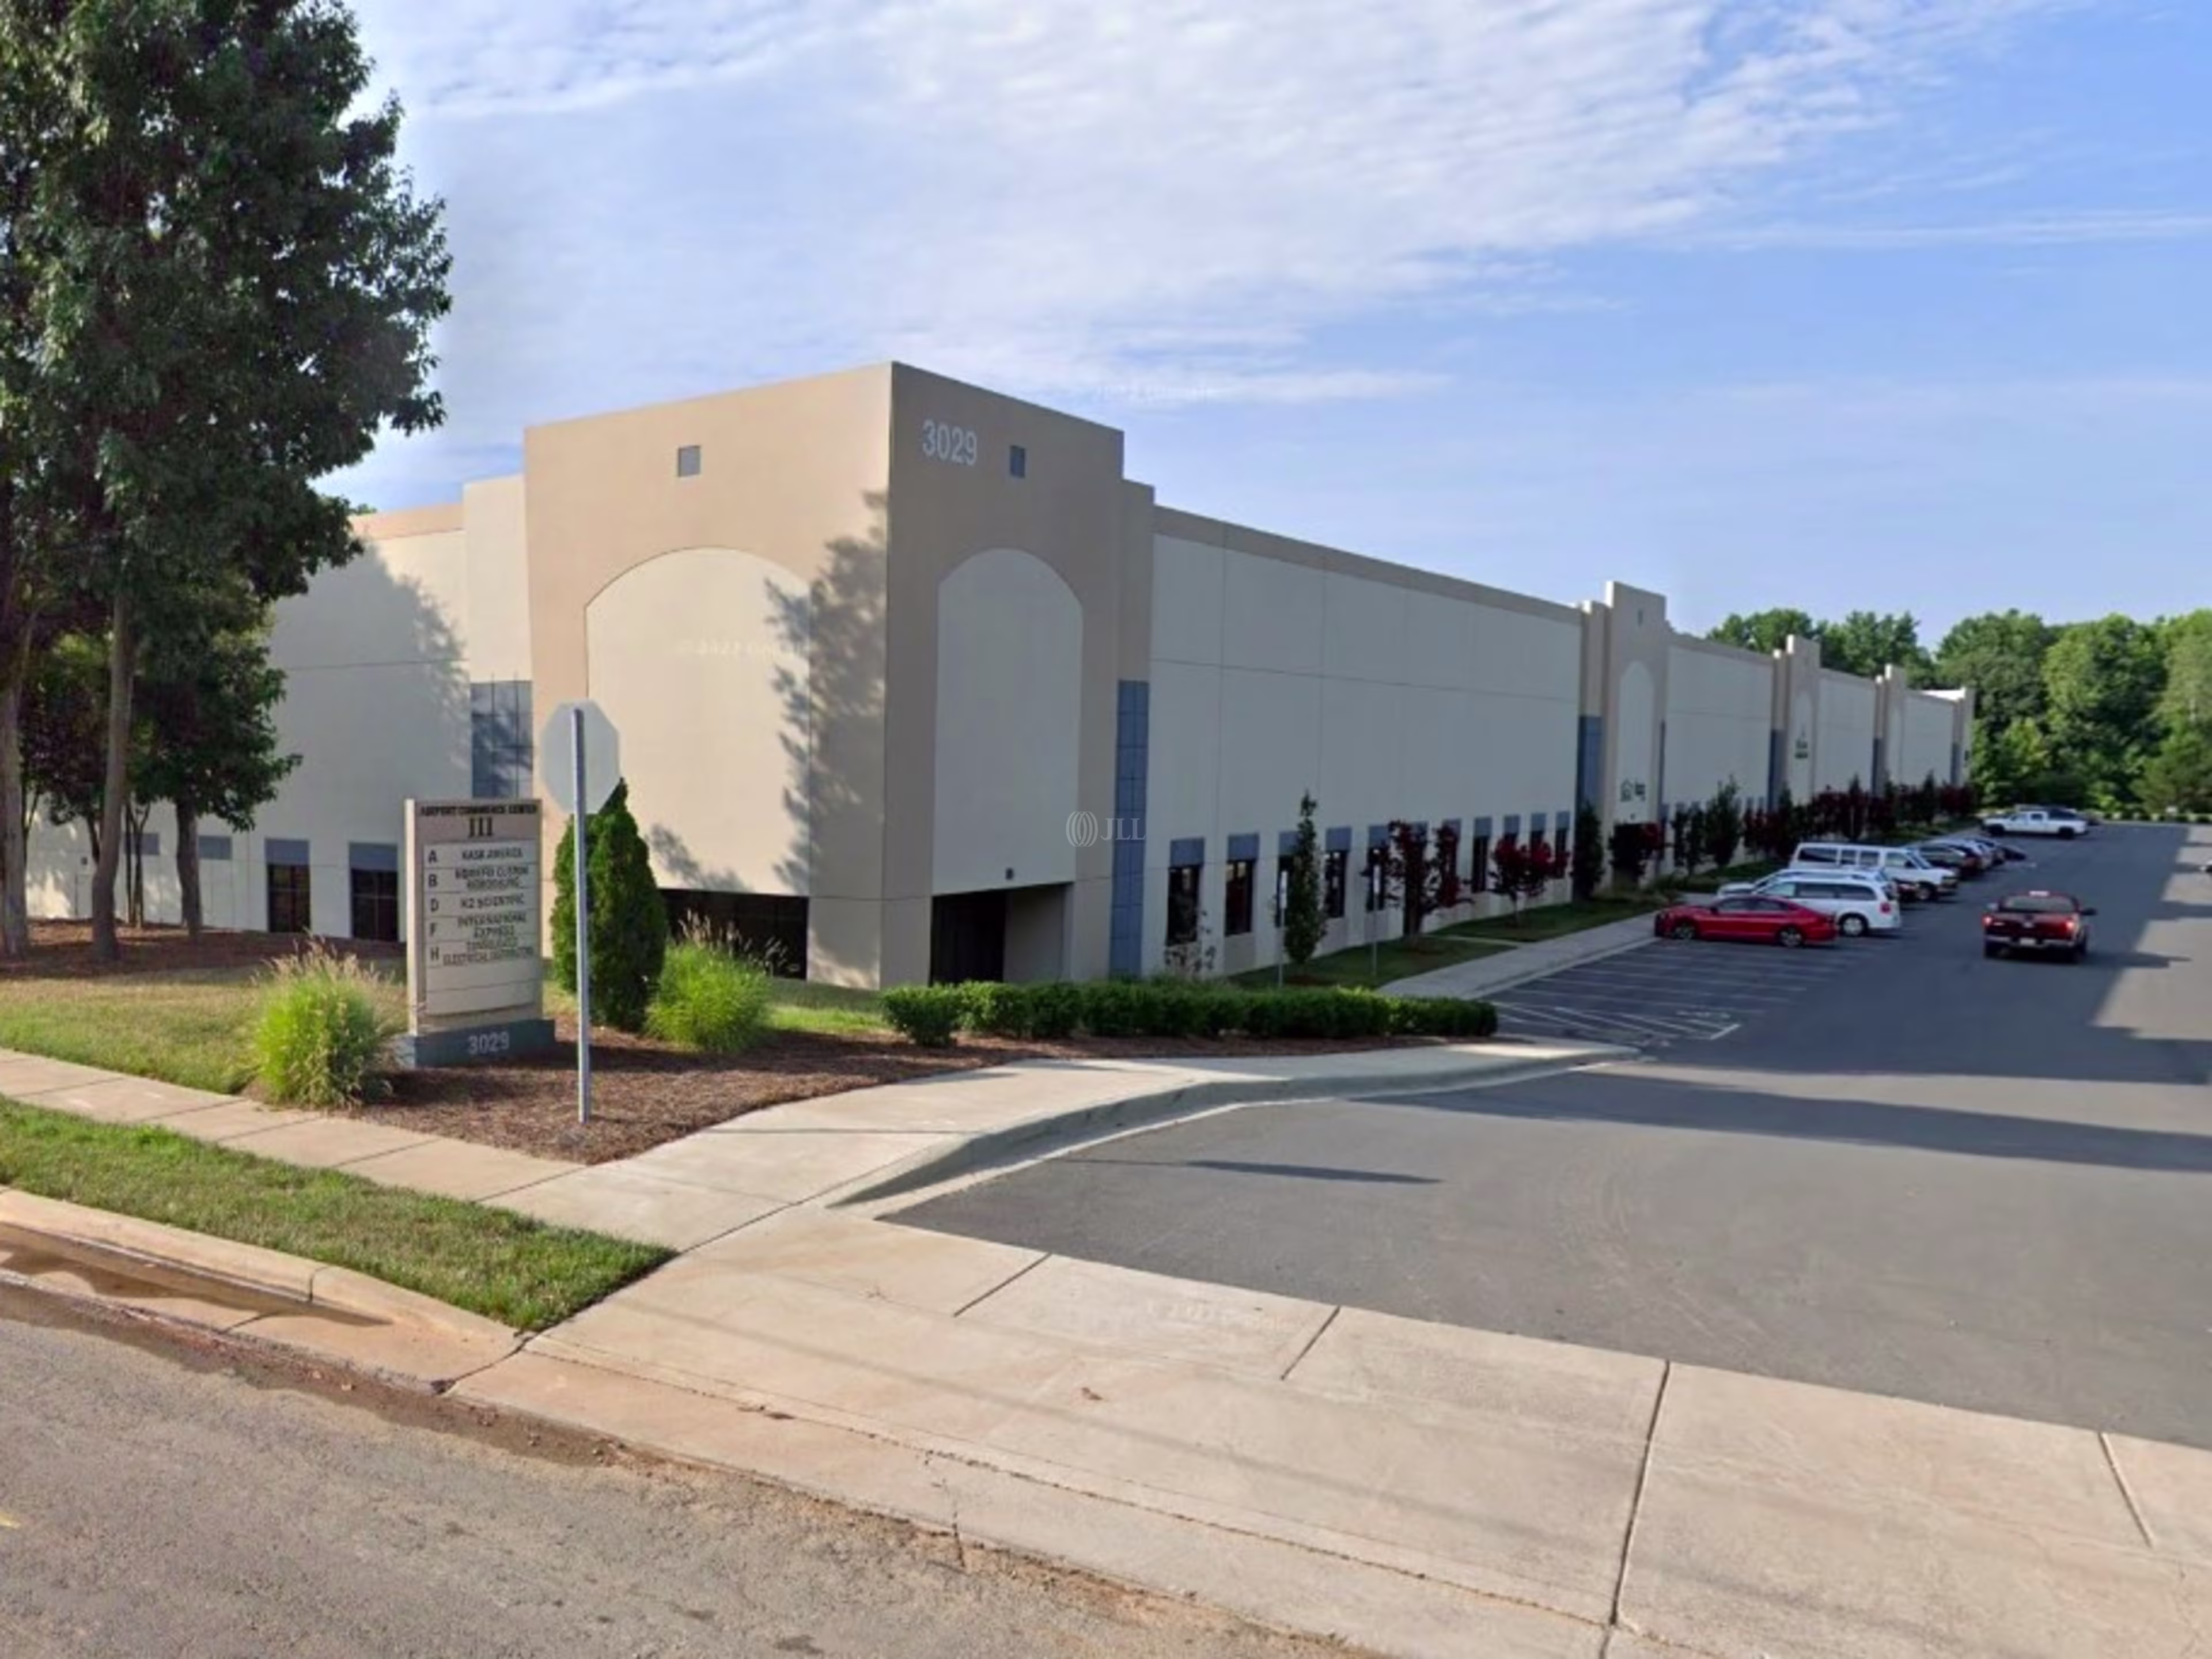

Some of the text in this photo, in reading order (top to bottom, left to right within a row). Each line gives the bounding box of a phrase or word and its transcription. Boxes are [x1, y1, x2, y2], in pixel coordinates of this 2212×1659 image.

[922, 419, 977, 466] 3029
[428, 850, 438, 863] A
[428, 874, 437, 887] B
[430, 898, 439, 912] D
[430, 923, 437, 937] F
[430, 946, 440, 961] H
[467, 1031, 510, 1055] 3029
